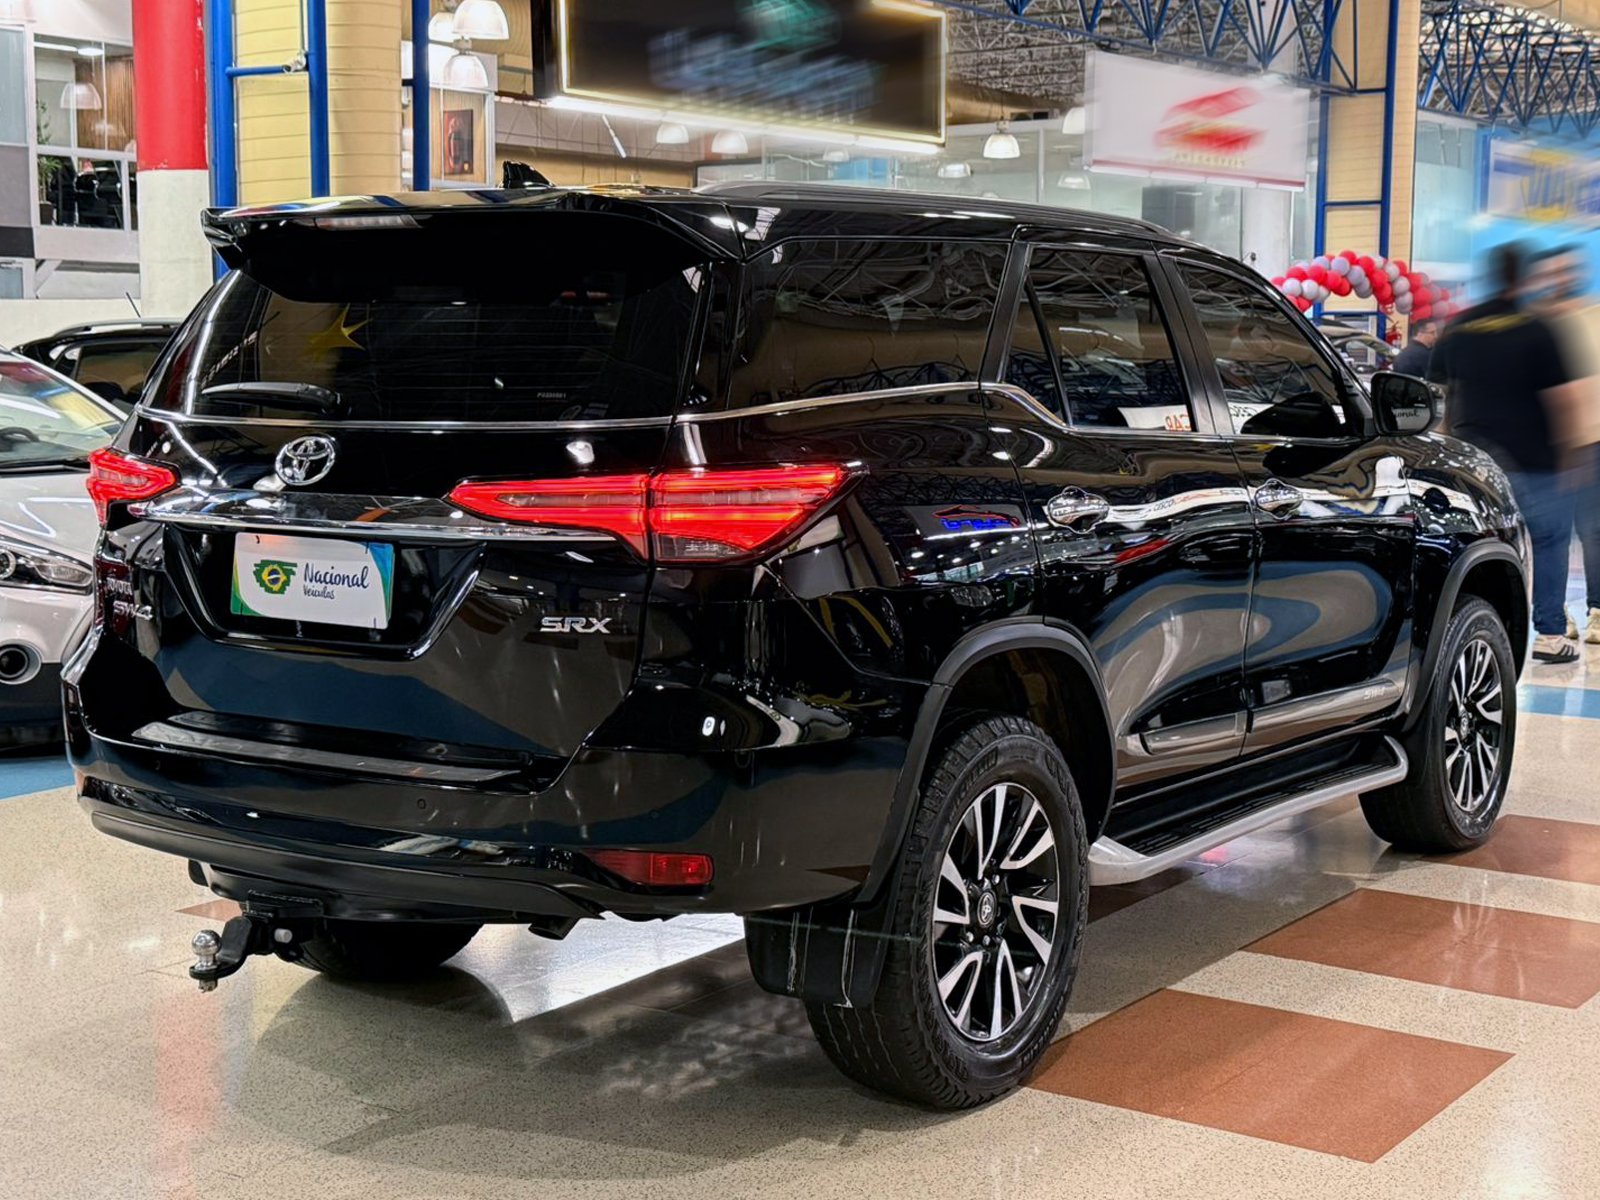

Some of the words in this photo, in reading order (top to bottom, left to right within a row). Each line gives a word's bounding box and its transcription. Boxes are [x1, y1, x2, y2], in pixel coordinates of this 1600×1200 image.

[304, 562, 369, 589] Nacional
[113, 601, 152, 620] SW4
[540, 616, 612, 634] SRX
